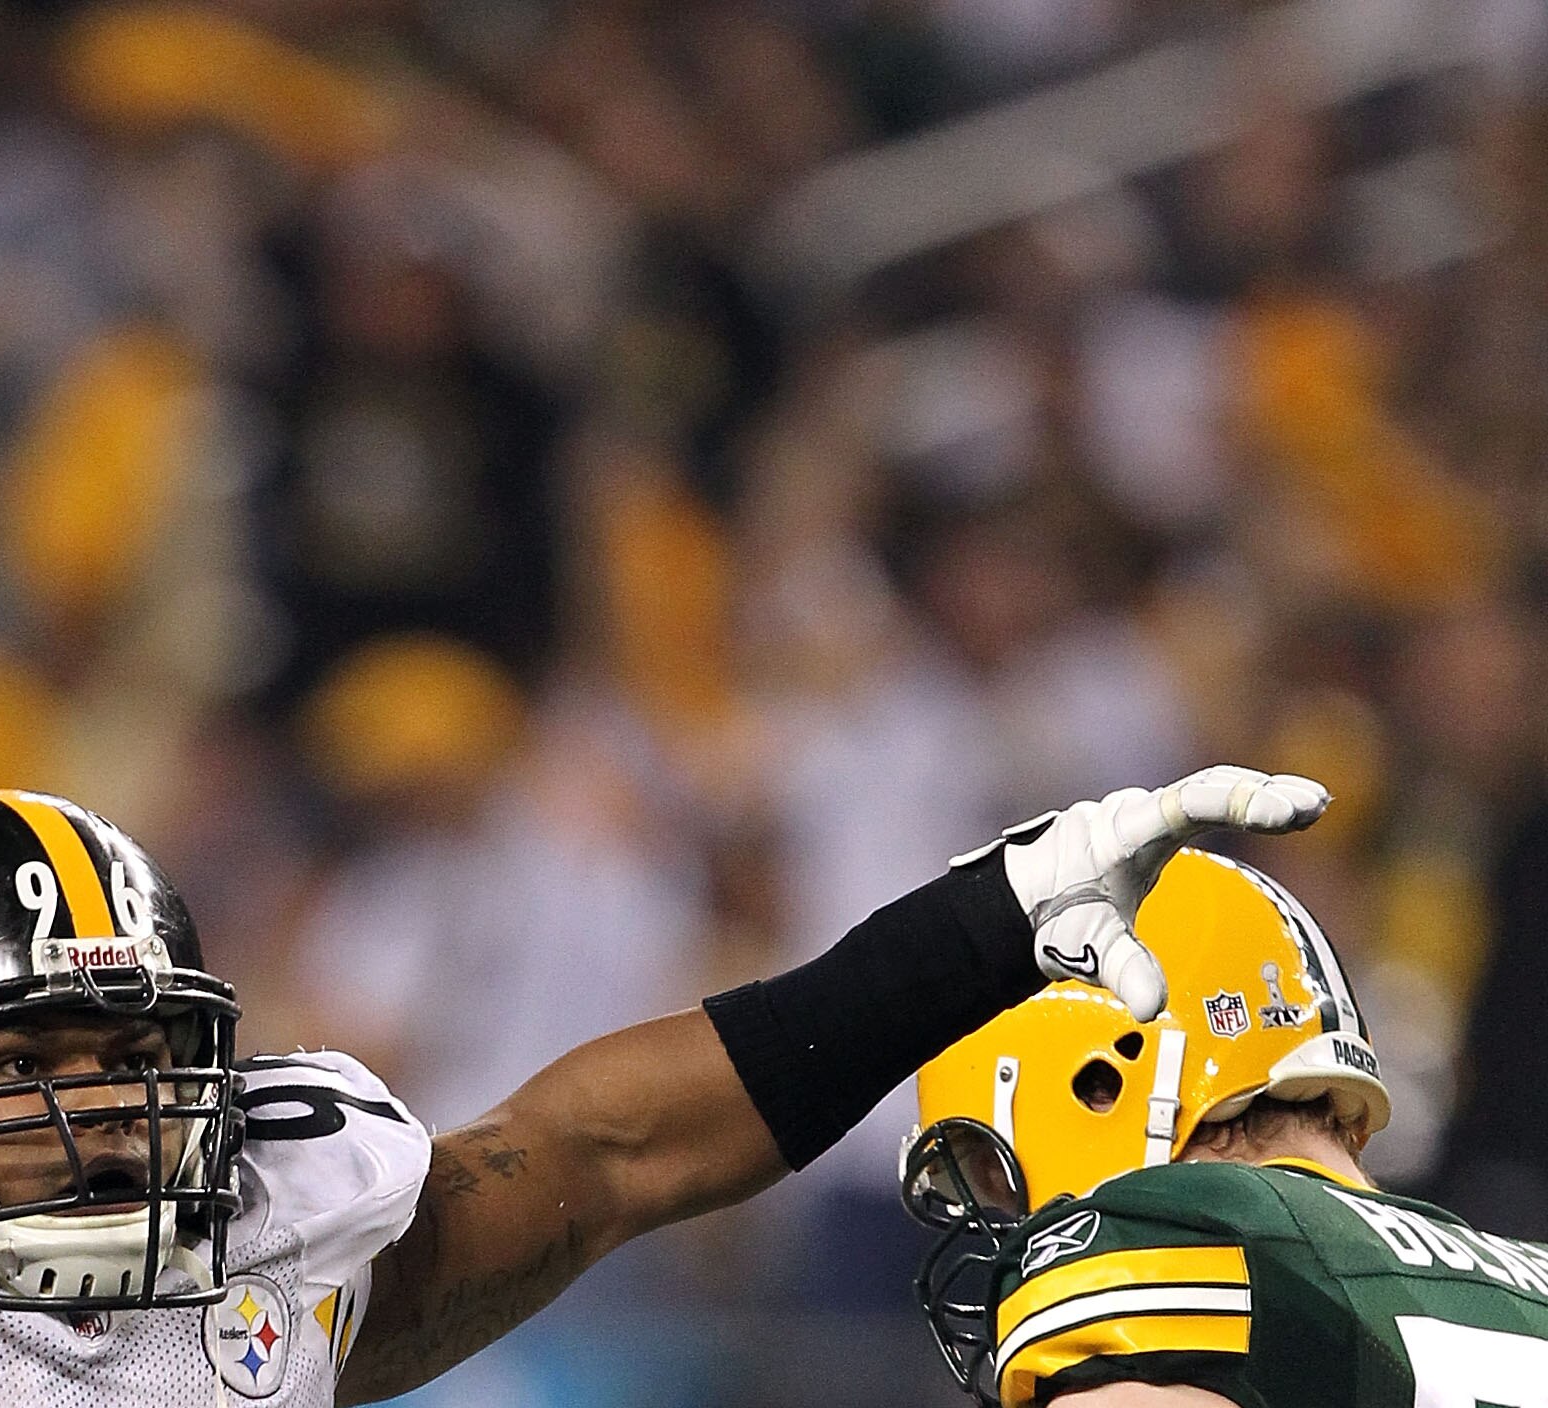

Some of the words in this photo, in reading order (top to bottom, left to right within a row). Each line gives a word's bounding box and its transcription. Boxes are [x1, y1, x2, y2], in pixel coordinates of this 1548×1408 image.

[15, 861, 154, 939] 96
[67, 946, 139, 967] Riddell
[1213, 1008, 1245, 1031] NFL
